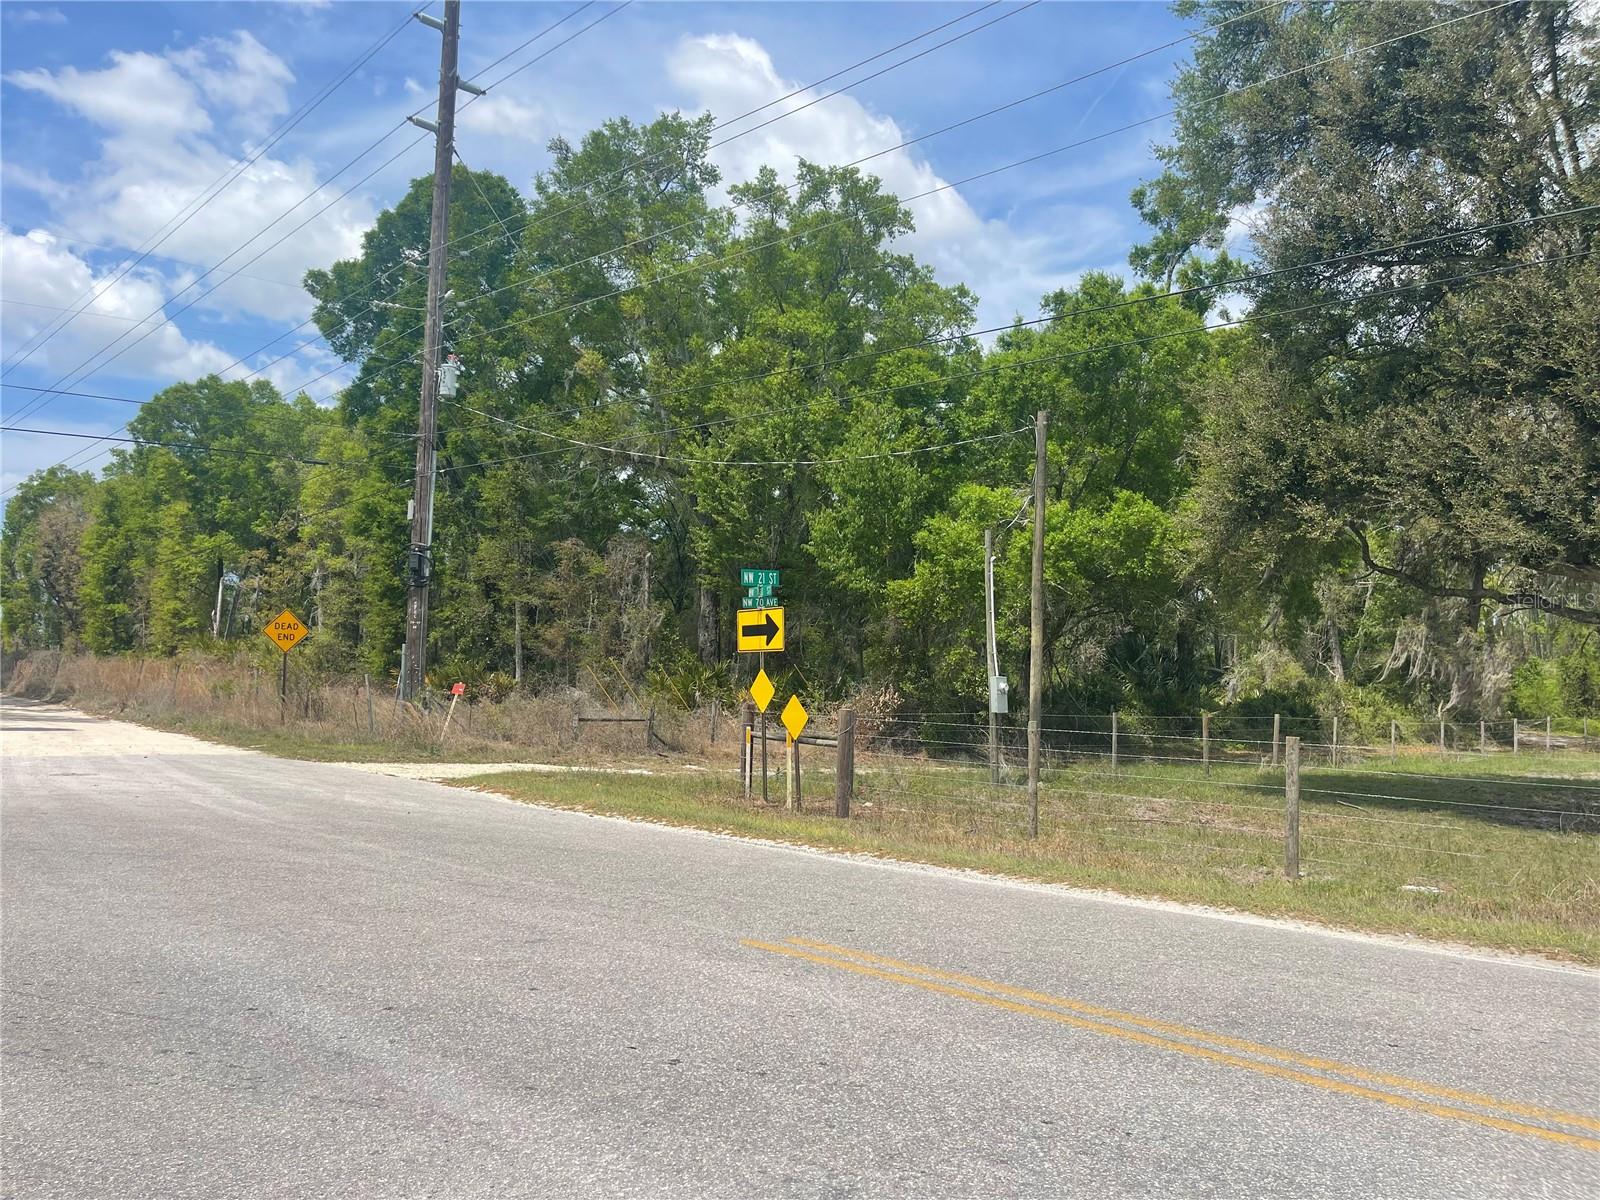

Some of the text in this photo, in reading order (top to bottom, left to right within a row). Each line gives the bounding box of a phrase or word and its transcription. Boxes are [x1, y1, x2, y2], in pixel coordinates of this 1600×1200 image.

[743, 571, 777, 585] NW 21 ST
[742, 598, 778, 607] NW 70 AVE
[274, 622, 299, 631] DEAD
[277, 632, 295, 641] END
